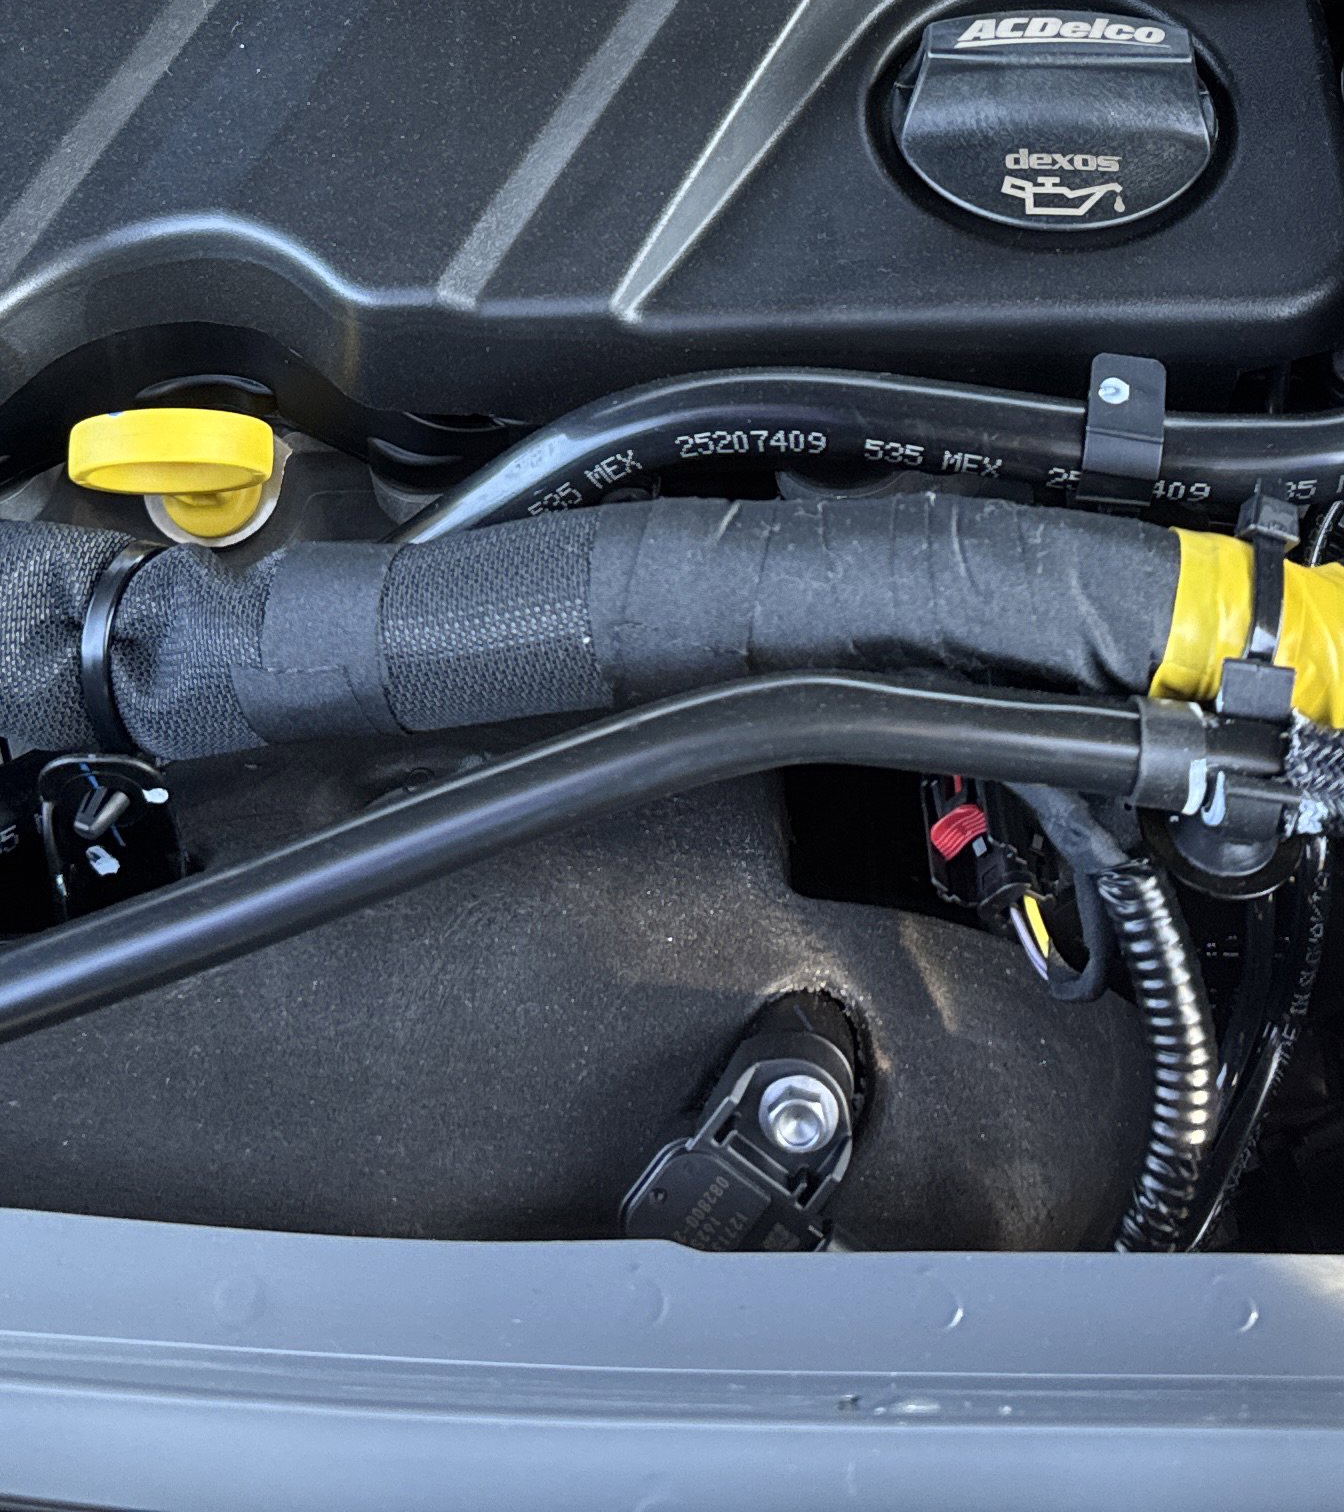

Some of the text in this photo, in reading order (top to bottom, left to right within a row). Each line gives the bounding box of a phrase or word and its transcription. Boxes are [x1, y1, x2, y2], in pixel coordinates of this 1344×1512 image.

[958, 17, 1166, 45] ACDelco
[1004, 148, 1123, 173] dexos
[584, 449, 643, 489] MEX
[674, 430, 827, 458] 25207409
[863, 438, 925, 466] 535
[941, 449, 1003, 479] MEX
